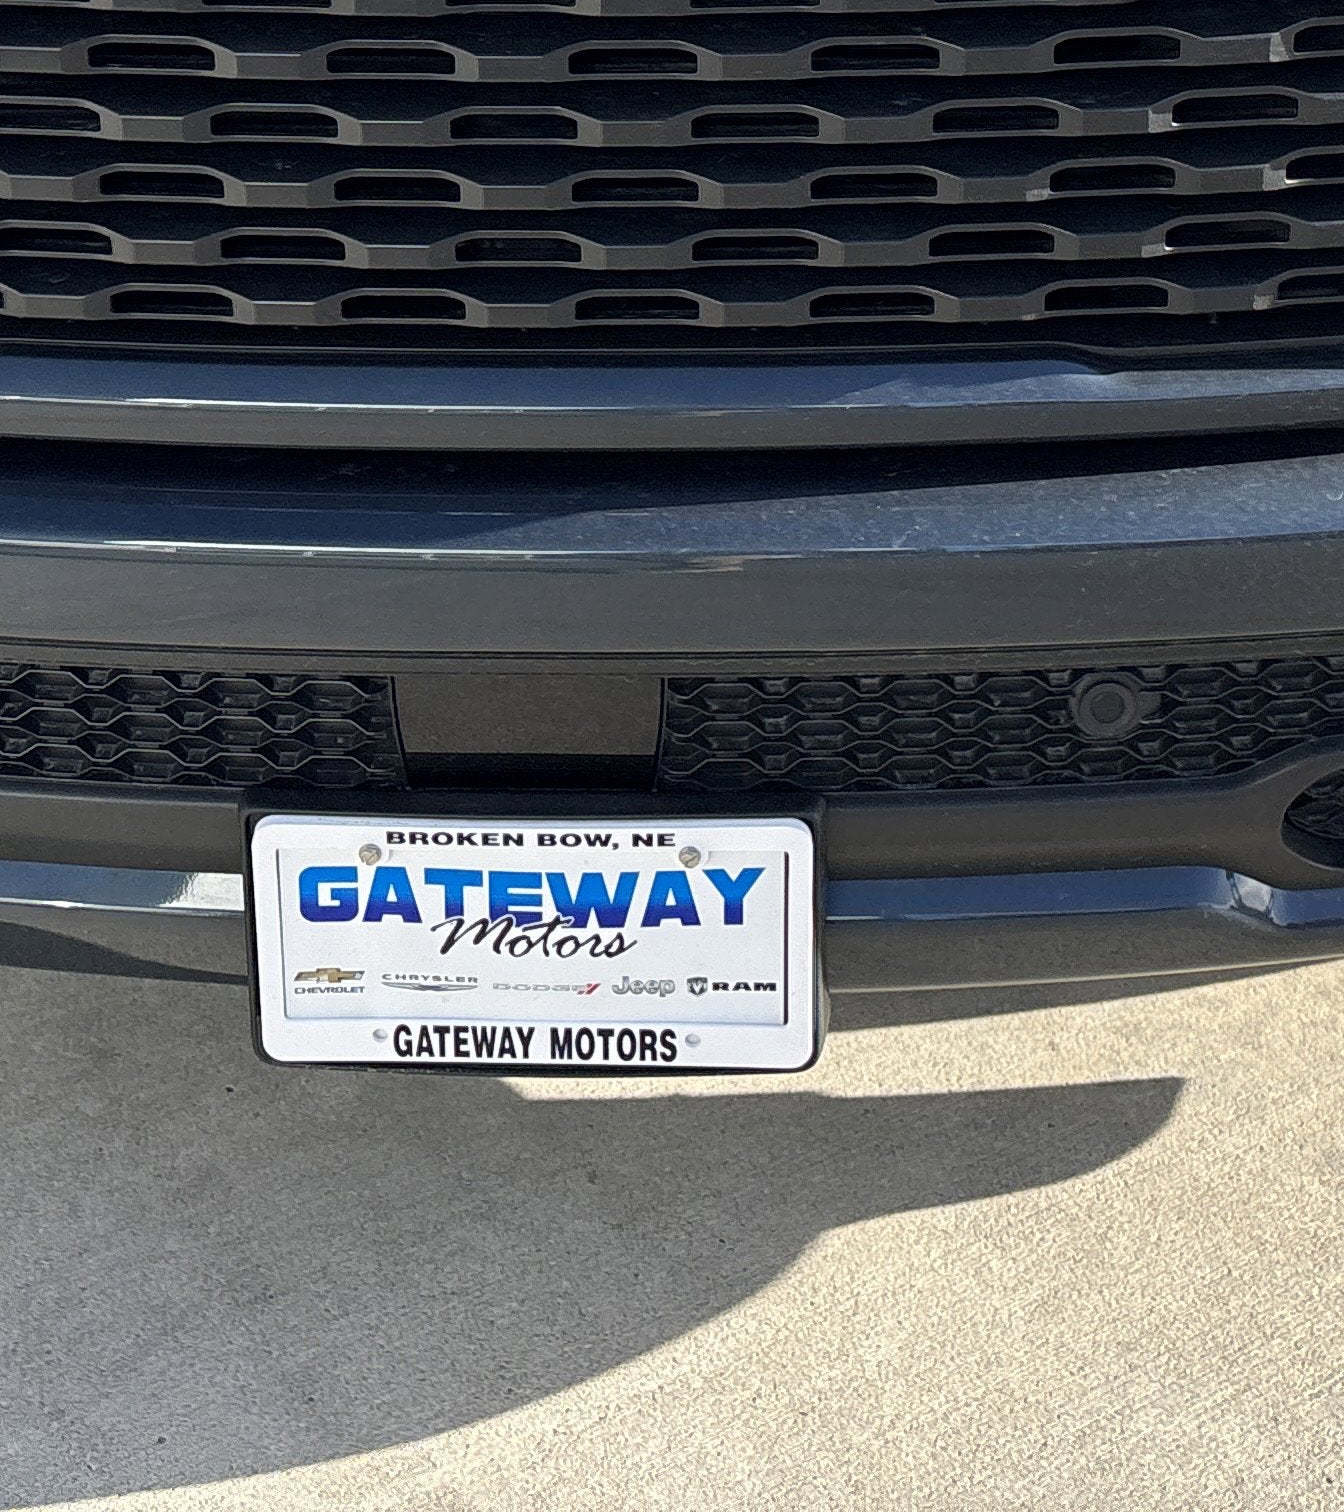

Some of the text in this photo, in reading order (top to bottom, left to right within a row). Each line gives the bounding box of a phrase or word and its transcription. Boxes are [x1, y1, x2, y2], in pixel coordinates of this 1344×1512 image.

[386, 831, 676, 849] BROKEN BOW, NE
[298, 866, 766, 928] GATEWAY
[431, 915, 638, 958] Motors
[381, 973, 479, 983] CHRYSLER
[612, 976, 676, 997] Jeep
[712, 982, 777, 992] RAM
[294, 986, 365, 994] CHEVROLET
[393, 1025, 678, 1062] GATEWAY MOTORS
